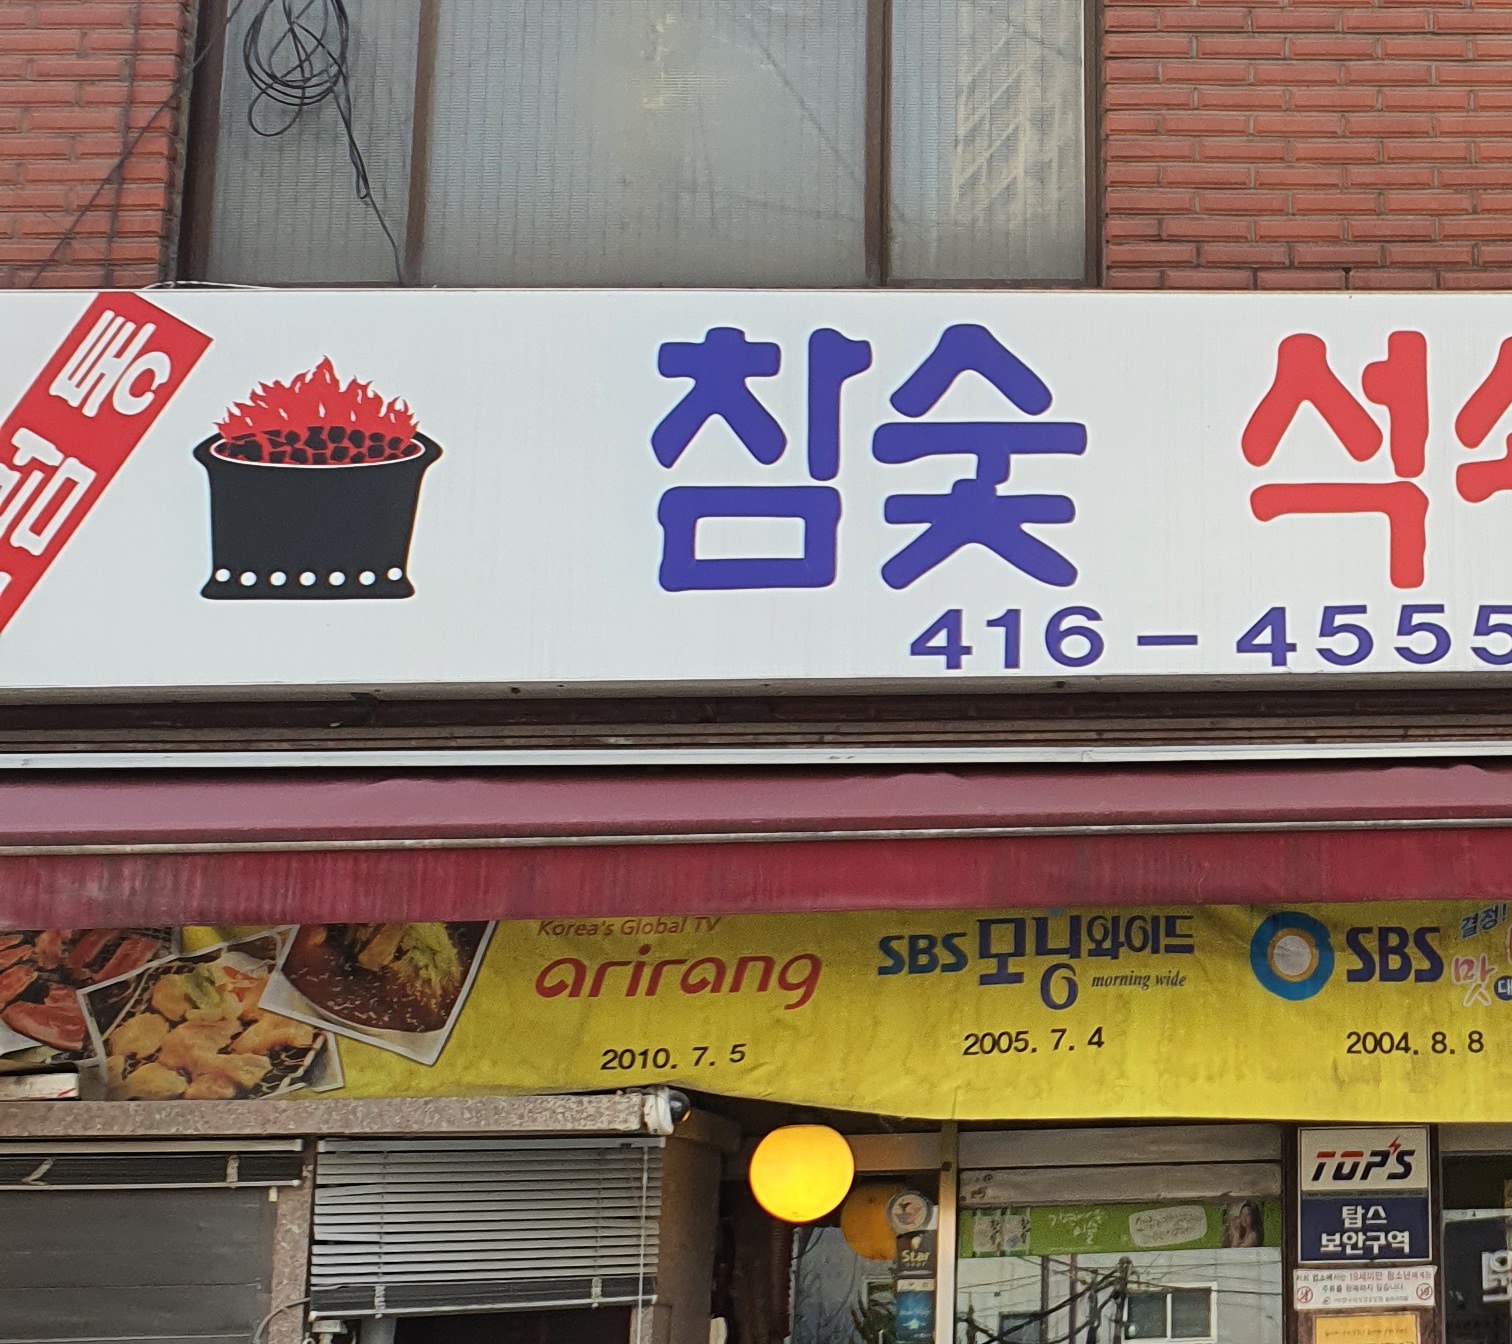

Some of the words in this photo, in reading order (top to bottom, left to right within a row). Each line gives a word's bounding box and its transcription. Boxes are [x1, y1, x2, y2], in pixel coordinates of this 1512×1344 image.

[650, 322, 1088, 593] 참숯
[536, 918, 614, 939] Korea's
[620, 916, 684, 937] Global
[693, 916, 722, 934] TV
[876, 931, 969, 977] SBS
[976, 913, 1196, 1011] 모닝와이드
[1345, 925, 1445, 984] SBS
[534, 943, 823, 1011] arirang
[1091, 971, 1151, 991] morning
[1155, 969, 1188, 989] wide
[1341, 1204, 1389, 1229] 탑스
[1319, 1230, 1411, 1255] 보안구역
